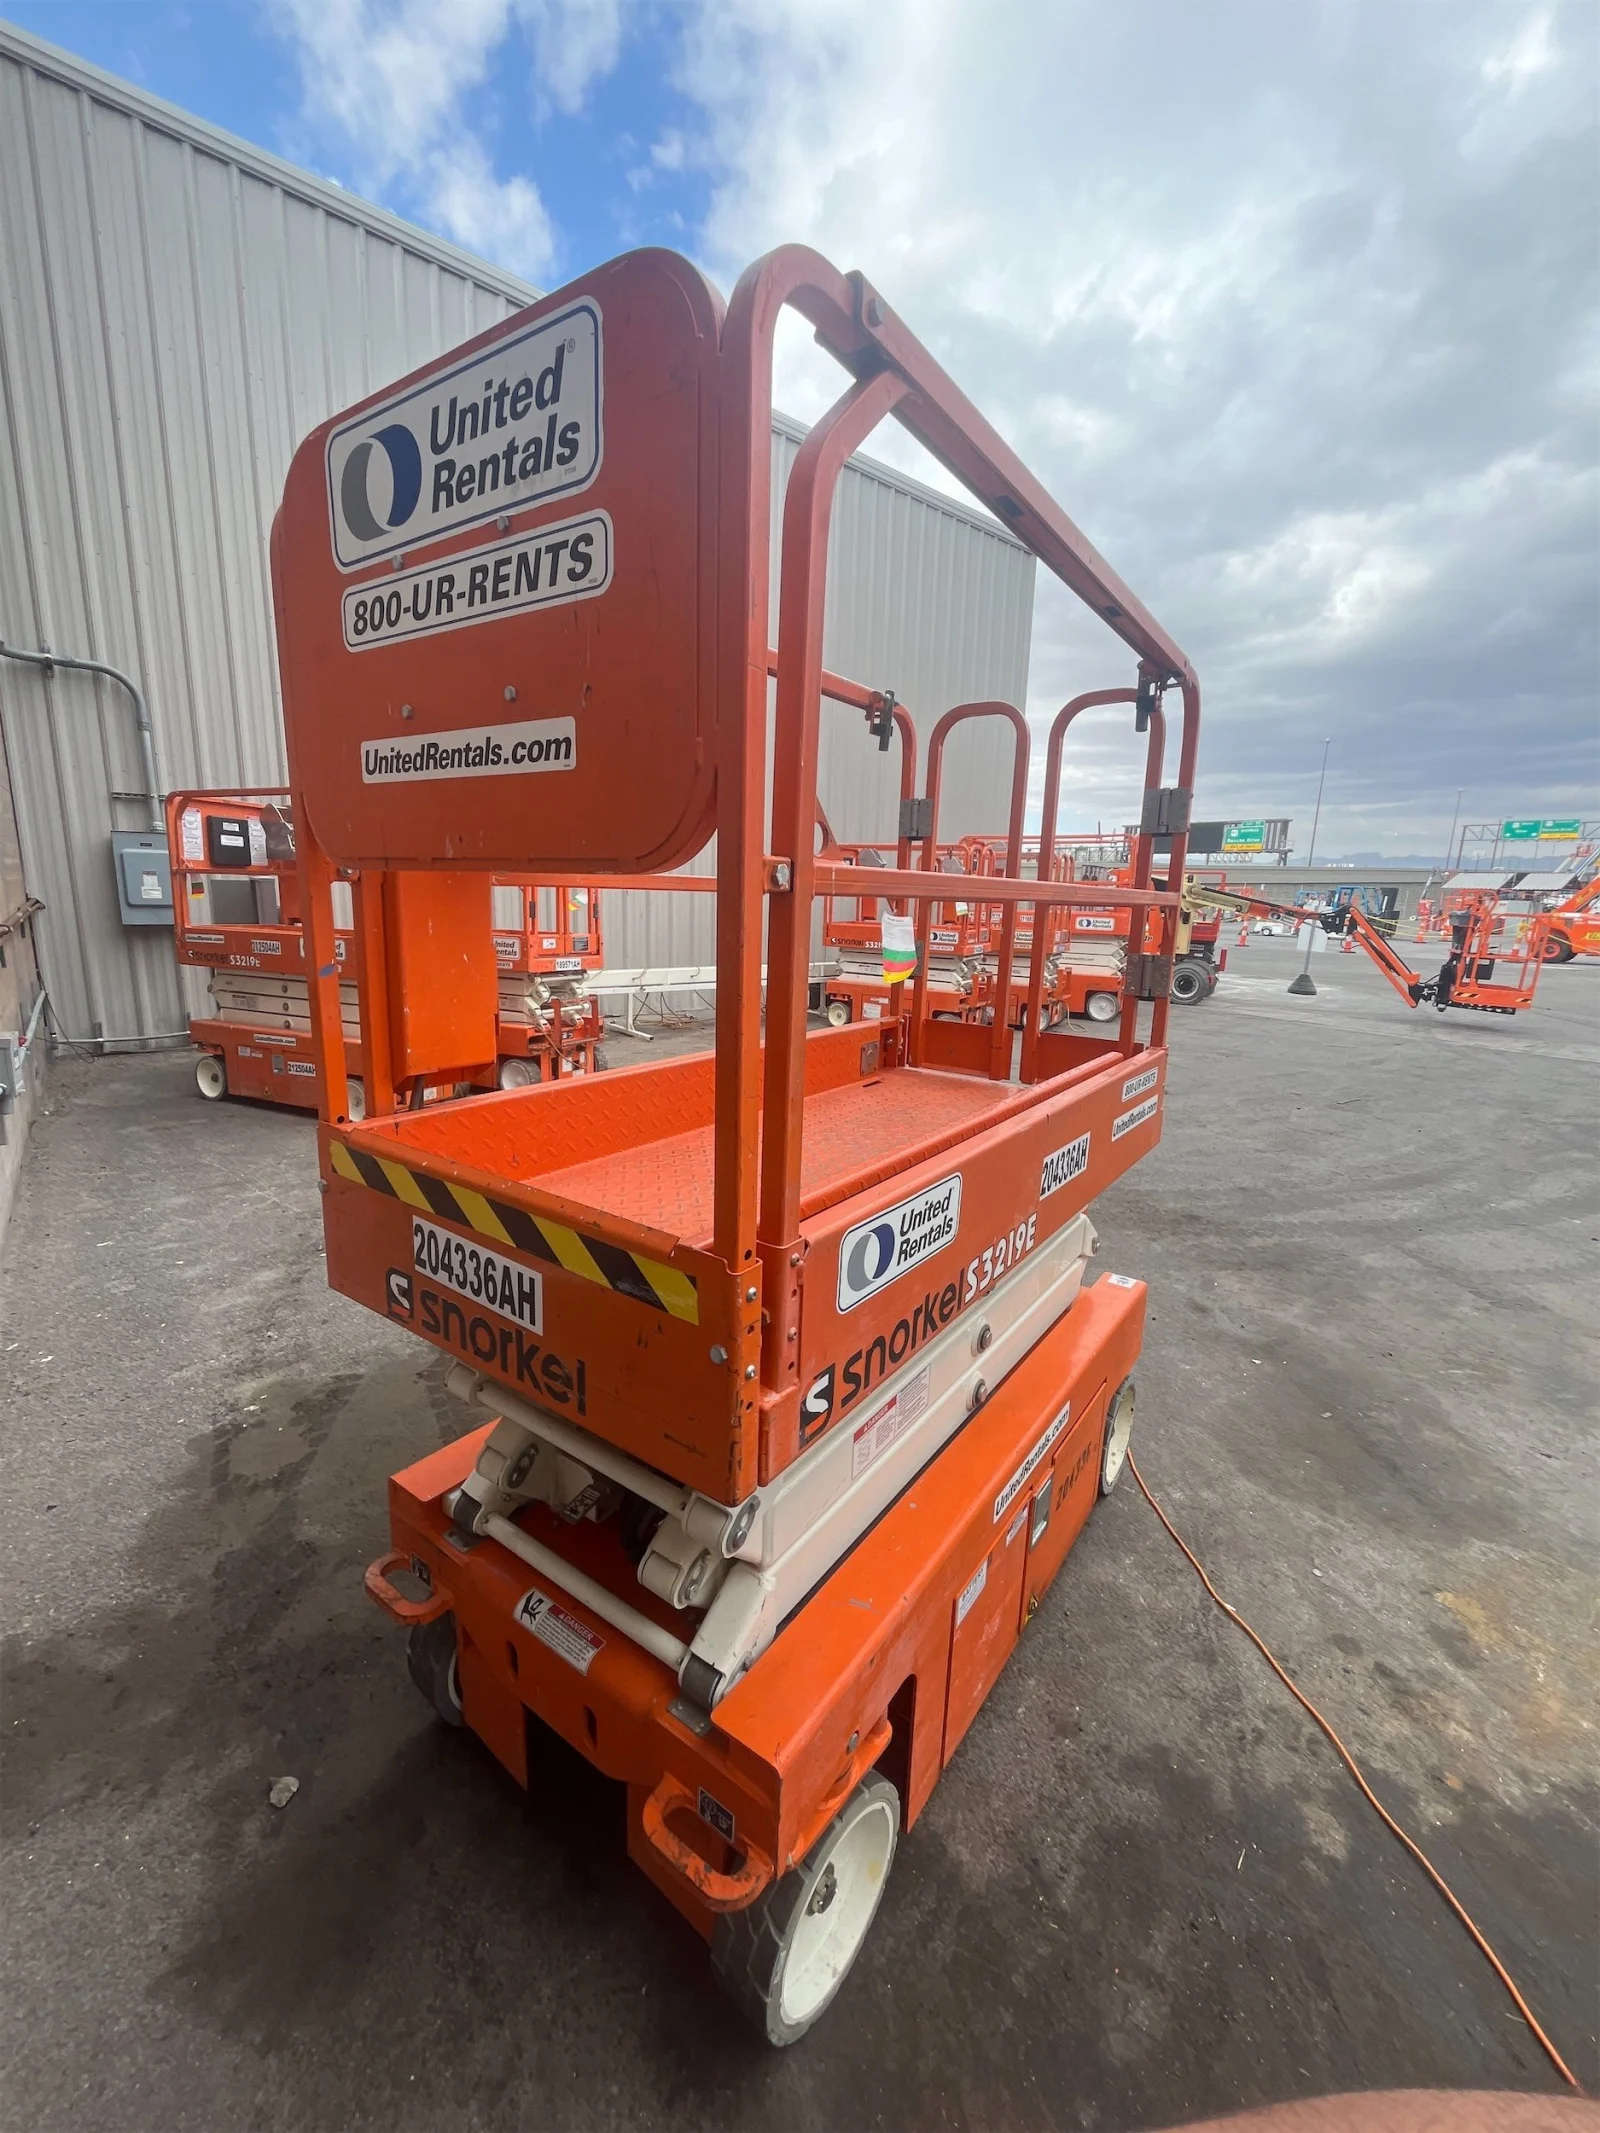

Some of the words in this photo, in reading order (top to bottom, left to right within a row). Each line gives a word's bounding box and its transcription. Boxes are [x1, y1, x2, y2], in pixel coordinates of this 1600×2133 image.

[429, 343, 566, 456] United
[431, 412, 581, 514] Rentals
[352, 532, 593, 637] 800-UR-RENTS
[364, 734, 572, 777] UnitedRentals.com
[899, 1187, 953, 1238] United
[1040, 1137, 1088, 1198] 204336AH
[413, 1222, 537, 1328] 204336AH
[896, 1214, 954, 1267] Rentals
[420, 1288, 587, 1417] snorkel
[841, 1268, 965, 1409] snorkel
[963, 1212, 1038, 1306] S3219E
[563, 1614, 595, 1642] DANGER
